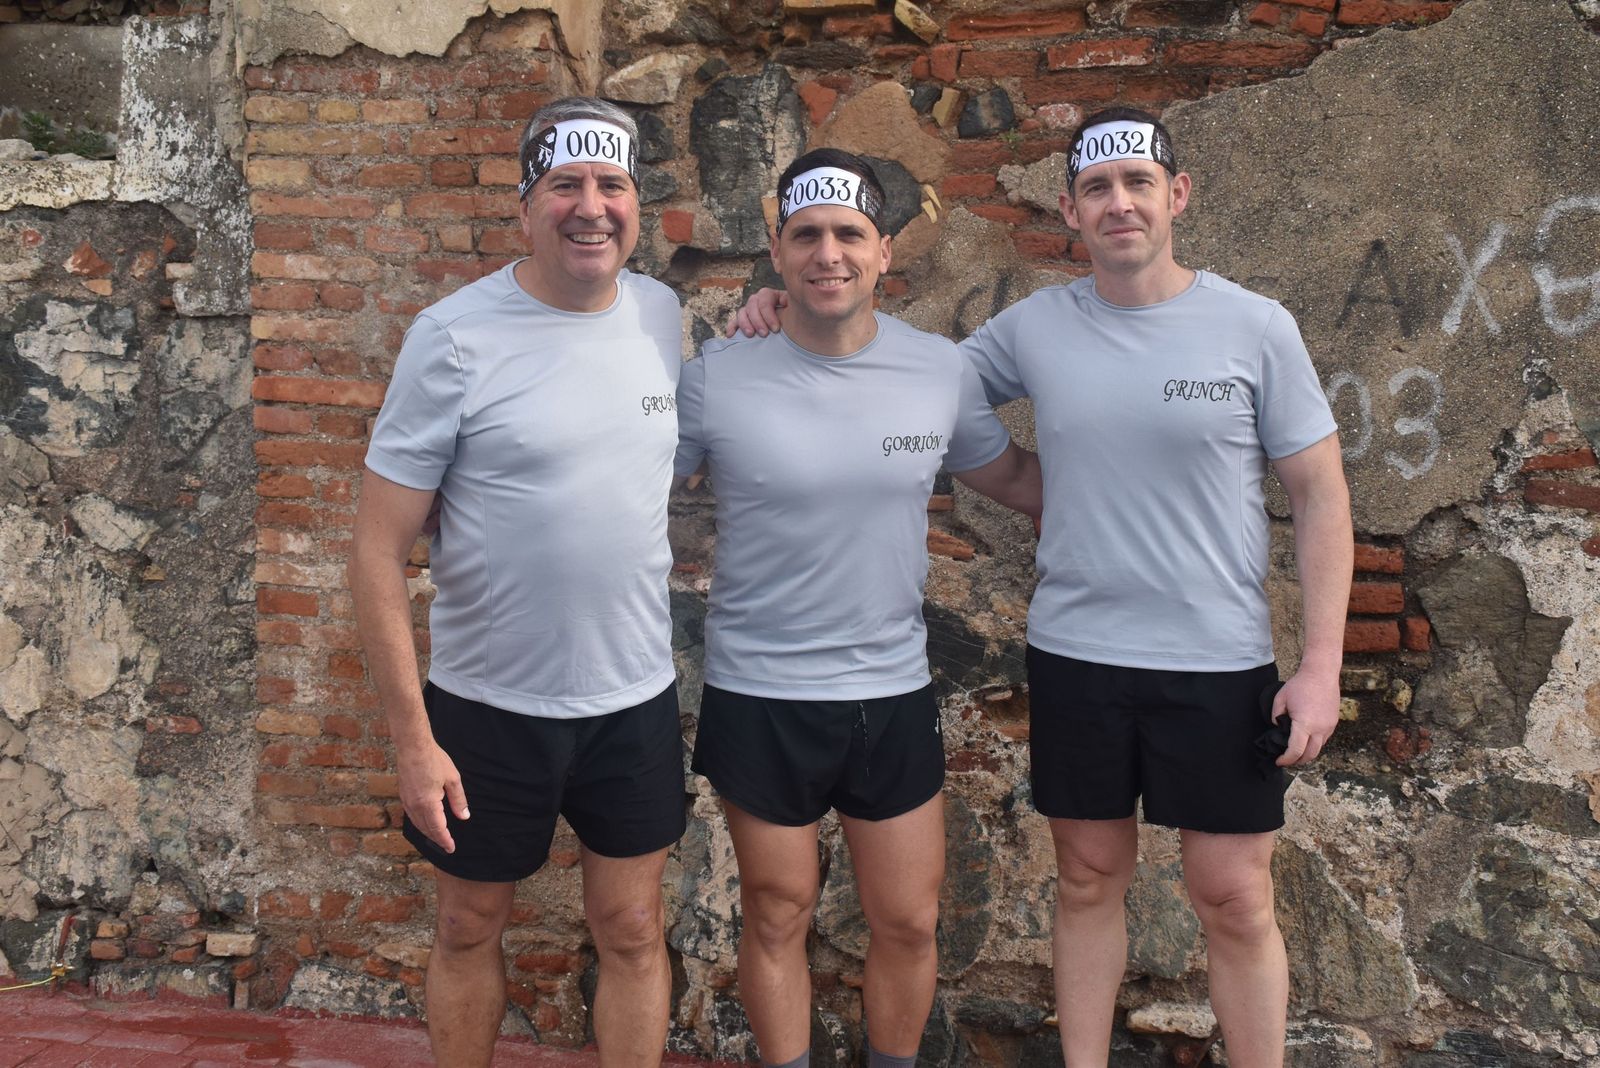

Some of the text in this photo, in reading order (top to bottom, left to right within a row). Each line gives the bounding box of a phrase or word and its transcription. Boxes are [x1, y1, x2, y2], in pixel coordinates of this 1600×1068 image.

[566, 130, 622, 163] 0031
[1086, 130, 1146, 161] 0032
[793, 176, 851, 206] 0033
[1163, 379, 1236, 402] GRINCH
[882, 431, 943, 457] GORRIÓN
